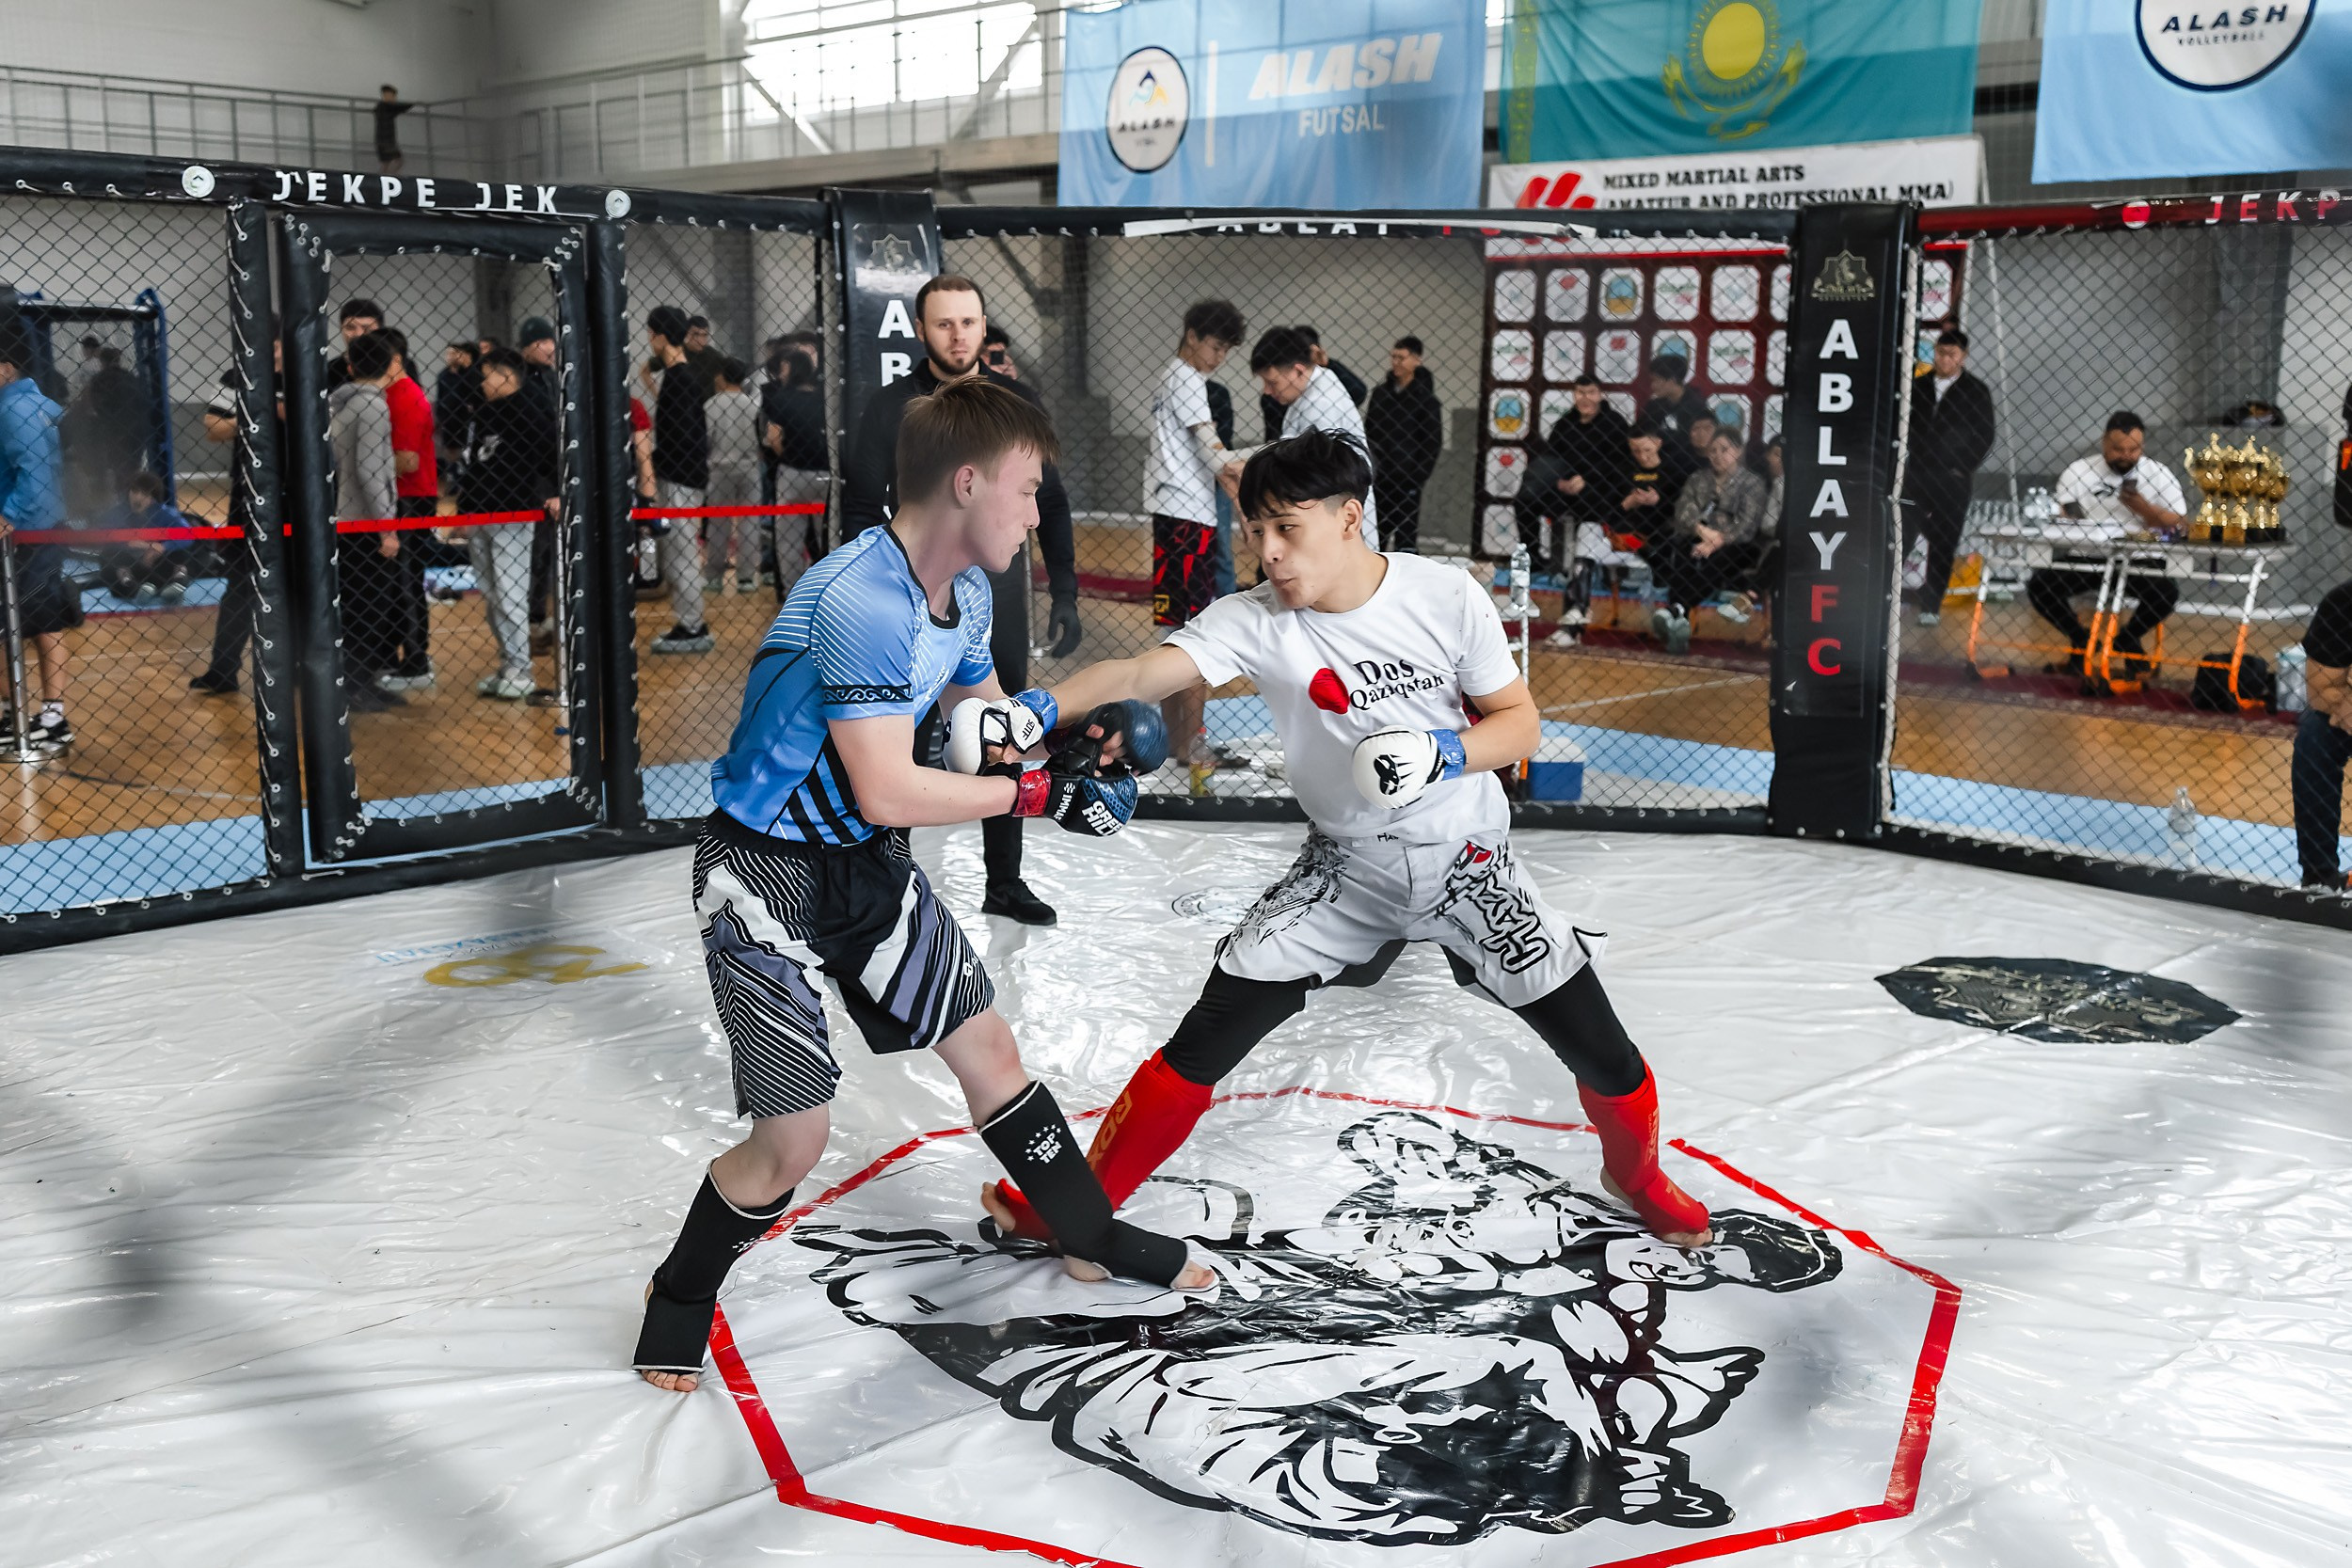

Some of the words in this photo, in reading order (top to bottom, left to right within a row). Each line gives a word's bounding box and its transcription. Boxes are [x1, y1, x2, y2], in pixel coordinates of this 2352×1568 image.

[2162, 4, 2288, 33] ALASH
[1248, 32, 1443, 101] ALASH
[1298, 103, 1385, 138] FUTSAL
[1603, 172, 1660, 190] MIXED
[1666, 166, 1747, 187] MARTIAL
[1756, 164, 1804, 183] ARTS
[475, 182, 558, 214] JEK
[1698, 194, 1738, 209] AND
[1809, 318, 1860, 571] ABLAY
[1806, 584, 1842, 676] FC
[1353, 658, 1415, 687] Dos
[1032, 1132, 1056, 1157] TOP
[1039, 1140, 1062, 1164] TEN
